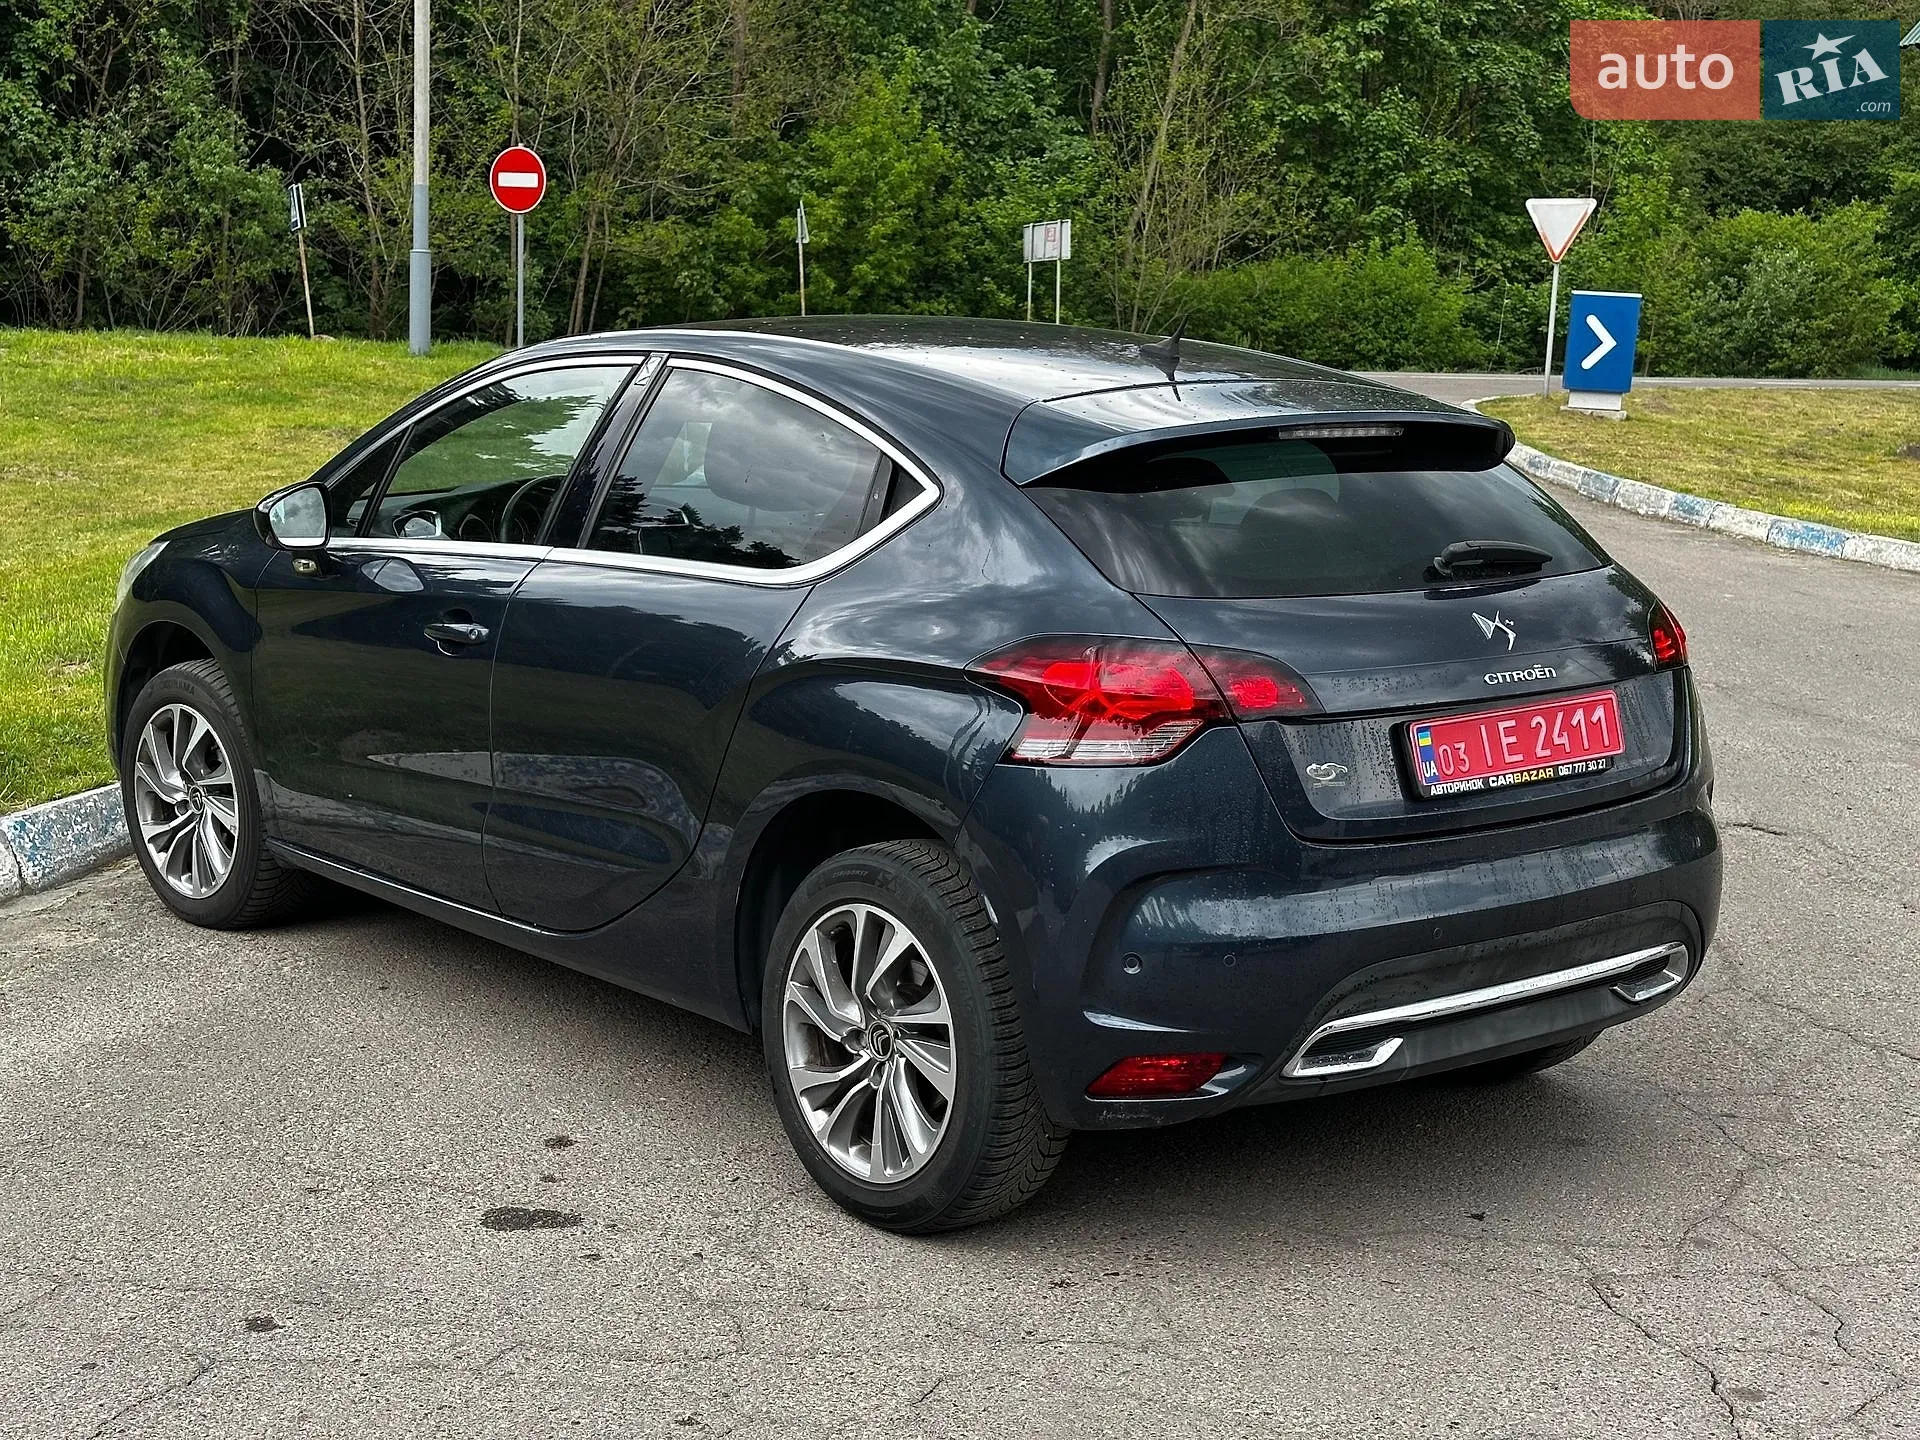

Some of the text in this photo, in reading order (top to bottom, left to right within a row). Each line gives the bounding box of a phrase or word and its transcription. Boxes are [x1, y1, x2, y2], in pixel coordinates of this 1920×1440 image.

[1438, 704, 1611, 776] 03 IE 2411
[1422, 760, 1439, 778] UA
[1430, 778, 1485, 796] АВТОРИНОК
[1488, 768, 1554, 787] CARBAZAR
